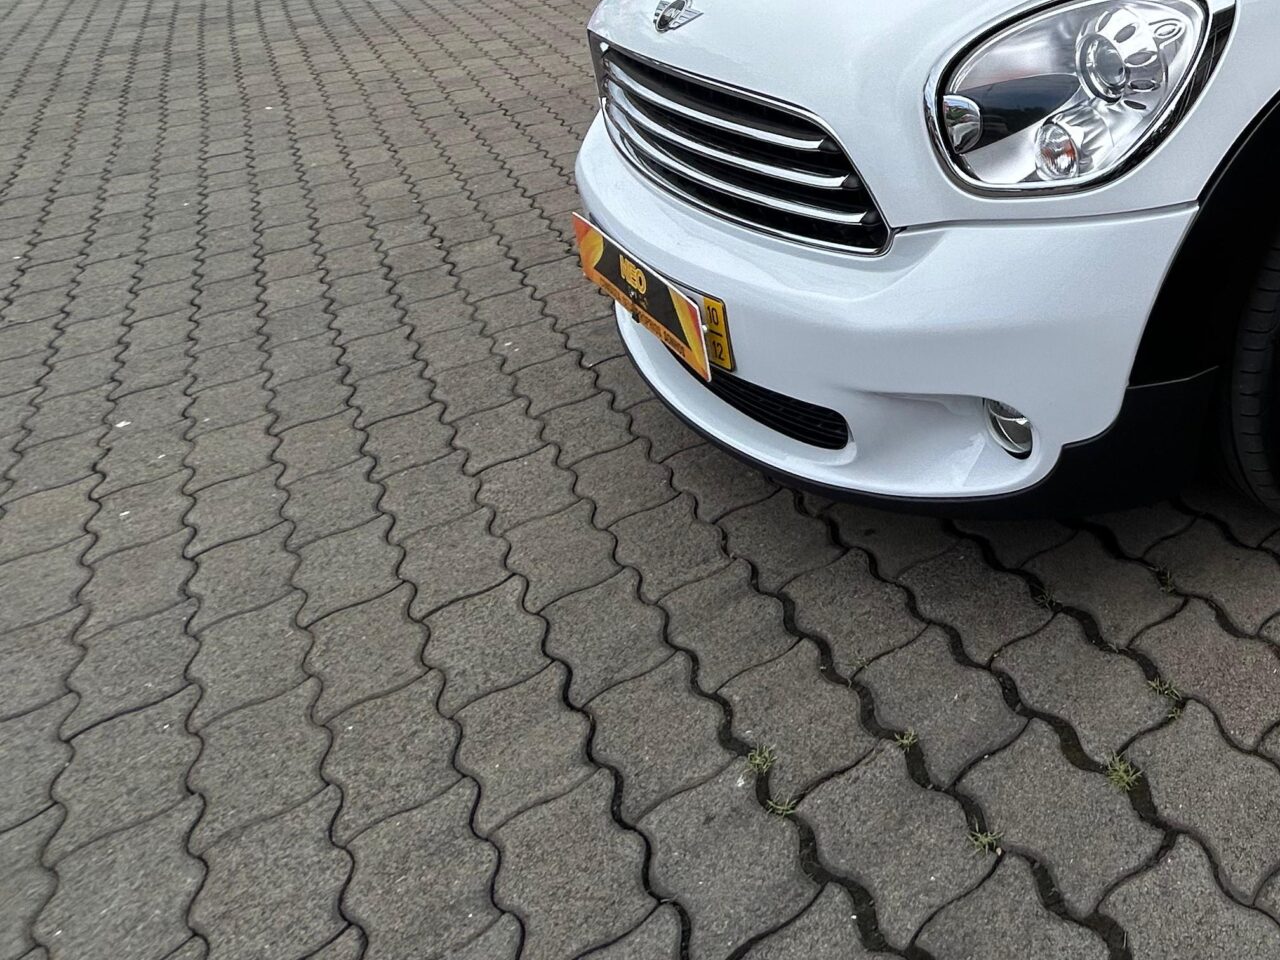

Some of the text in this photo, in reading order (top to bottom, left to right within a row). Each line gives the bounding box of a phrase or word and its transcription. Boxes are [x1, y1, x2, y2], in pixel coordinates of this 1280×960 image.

[619, 254, 646, 294] NEO
[707, 305, 719, 326] 10
[712, 340, 725, 361] 12
